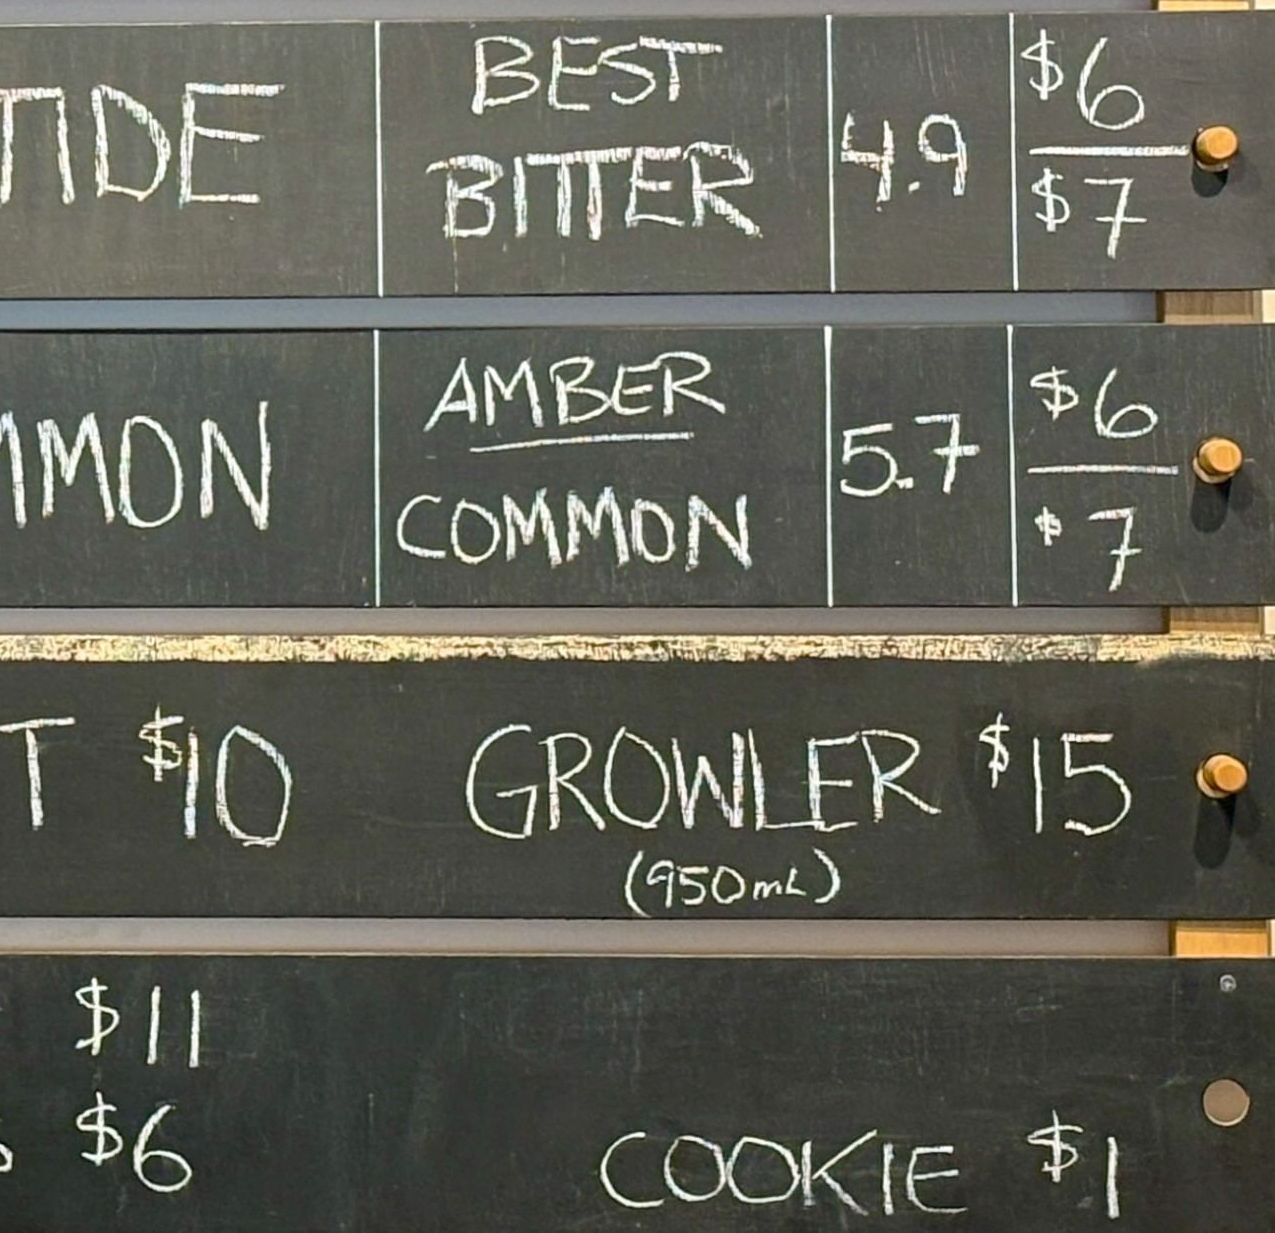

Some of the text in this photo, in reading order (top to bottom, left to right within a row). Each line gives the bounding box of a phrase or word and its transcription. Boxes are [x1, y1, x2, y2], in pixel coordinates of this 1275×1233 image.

[472, 36, 725, 114] BEST
[1019, 29, 1145, 133] $6
[426, 141, 764, 241] BITTER
[840, 112, 969, 214] 4.9
[1031, 167, 1148, 258] $7
[425, 351, 726, 432] AMBER
[1030, 368, 1158, 439] $6
[840, 414, 980, 498] 5.7
[396, 488, 752, 572] COMMON
[138, 706, 293, 849] $10
[465, 712, 1132, 839] GROWLER $15
[74, 978, 201, 1068] $11
[74, 1092, 193, 1193] $6
[601, 1111, 1121, 1219] COOKIE $1
